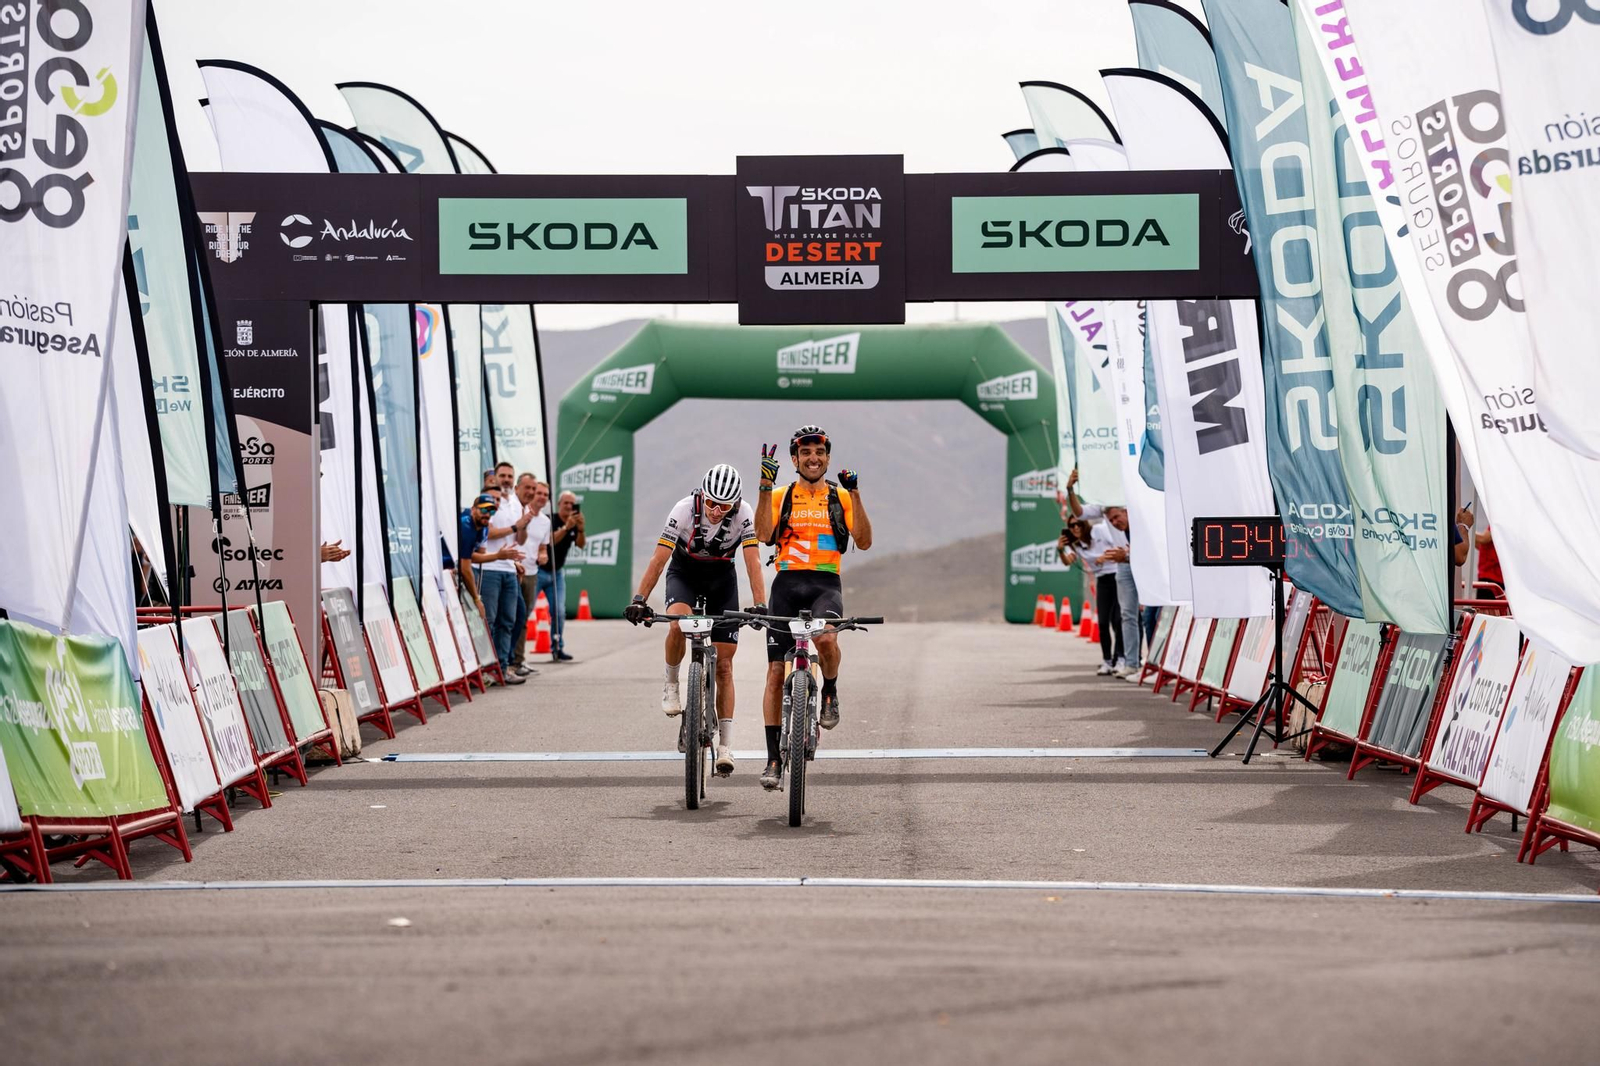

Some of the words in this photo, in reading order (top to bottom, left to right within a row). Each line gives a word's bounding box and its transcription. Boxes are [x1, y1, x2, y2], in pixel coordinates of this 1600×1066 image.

[801, 187, 882, 201] SKODA
[745, 185, 882, 232] TITAN
[205, 224, 223, 234] RIDE
[320, 218, 414, 241] Andalucía
[468, 222, 659, 250] SKODA
[980, 218, 1171, 248] SKODA
[208, 241, 226, 250] RIDE
[765, 242, 882, 262] DESERT
[780, 267, 864, 286] ALMERÍA
[247, 349, 259, 357] DE
[260, 347, 298, 357] ALMERÍA
[781, 341, 849, 366] FINISHER
[596, 370, 648, 389] FINISHER
[980, 376, 1031, 395] FINISHER
[233, 385, 285, 399] EJÉRCITO
[561, 465, 616, 485] FINISHER
[1013, 473, 1057, 491] FINISHE
[224, 487, 267, 505] FINISER
[693, 619, 699, 628] 3
[805, 621, 811, 629] 6
[1468, 677, 1494, 714] COSTA
[1490, 684, 1508, 718] DE
